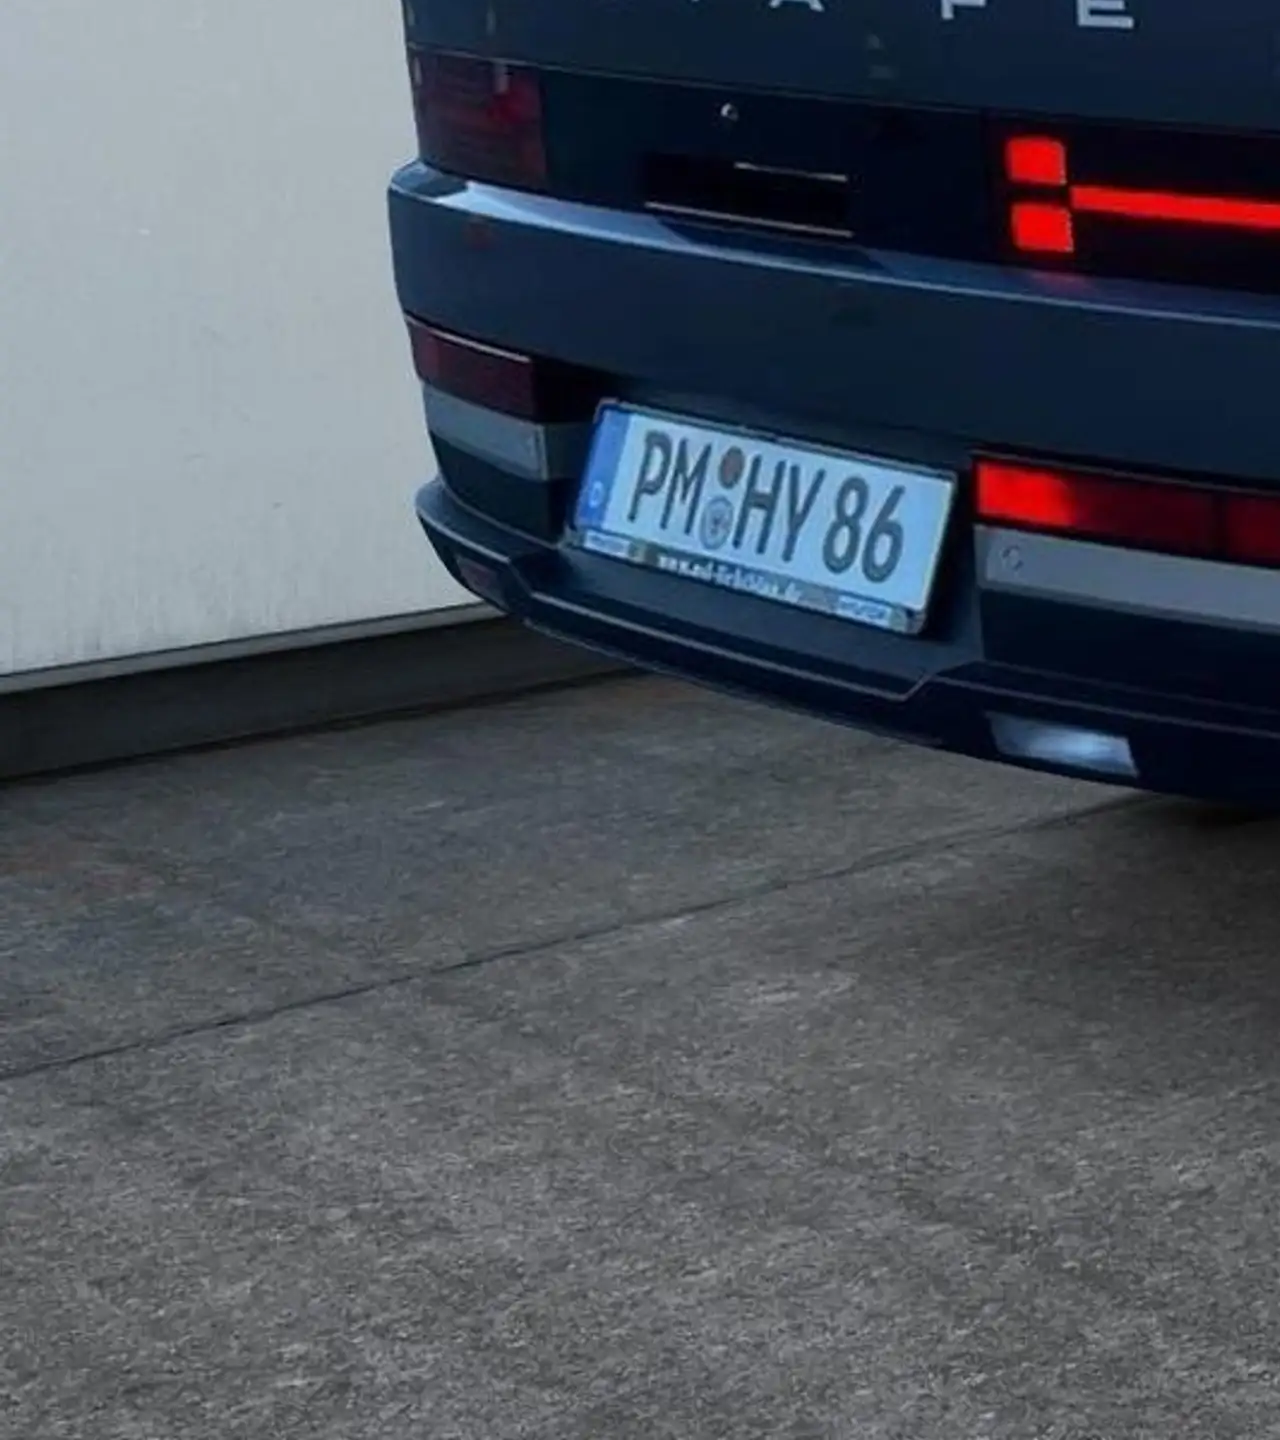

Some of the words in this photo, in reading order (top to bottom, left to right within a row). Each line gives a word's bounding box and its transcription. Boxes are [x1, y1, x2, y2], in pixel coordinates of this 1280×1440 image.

[626, 429, 712, 537] PM
[732, 454, 826, 563] HY
[822, 476, 906, 585] 86
